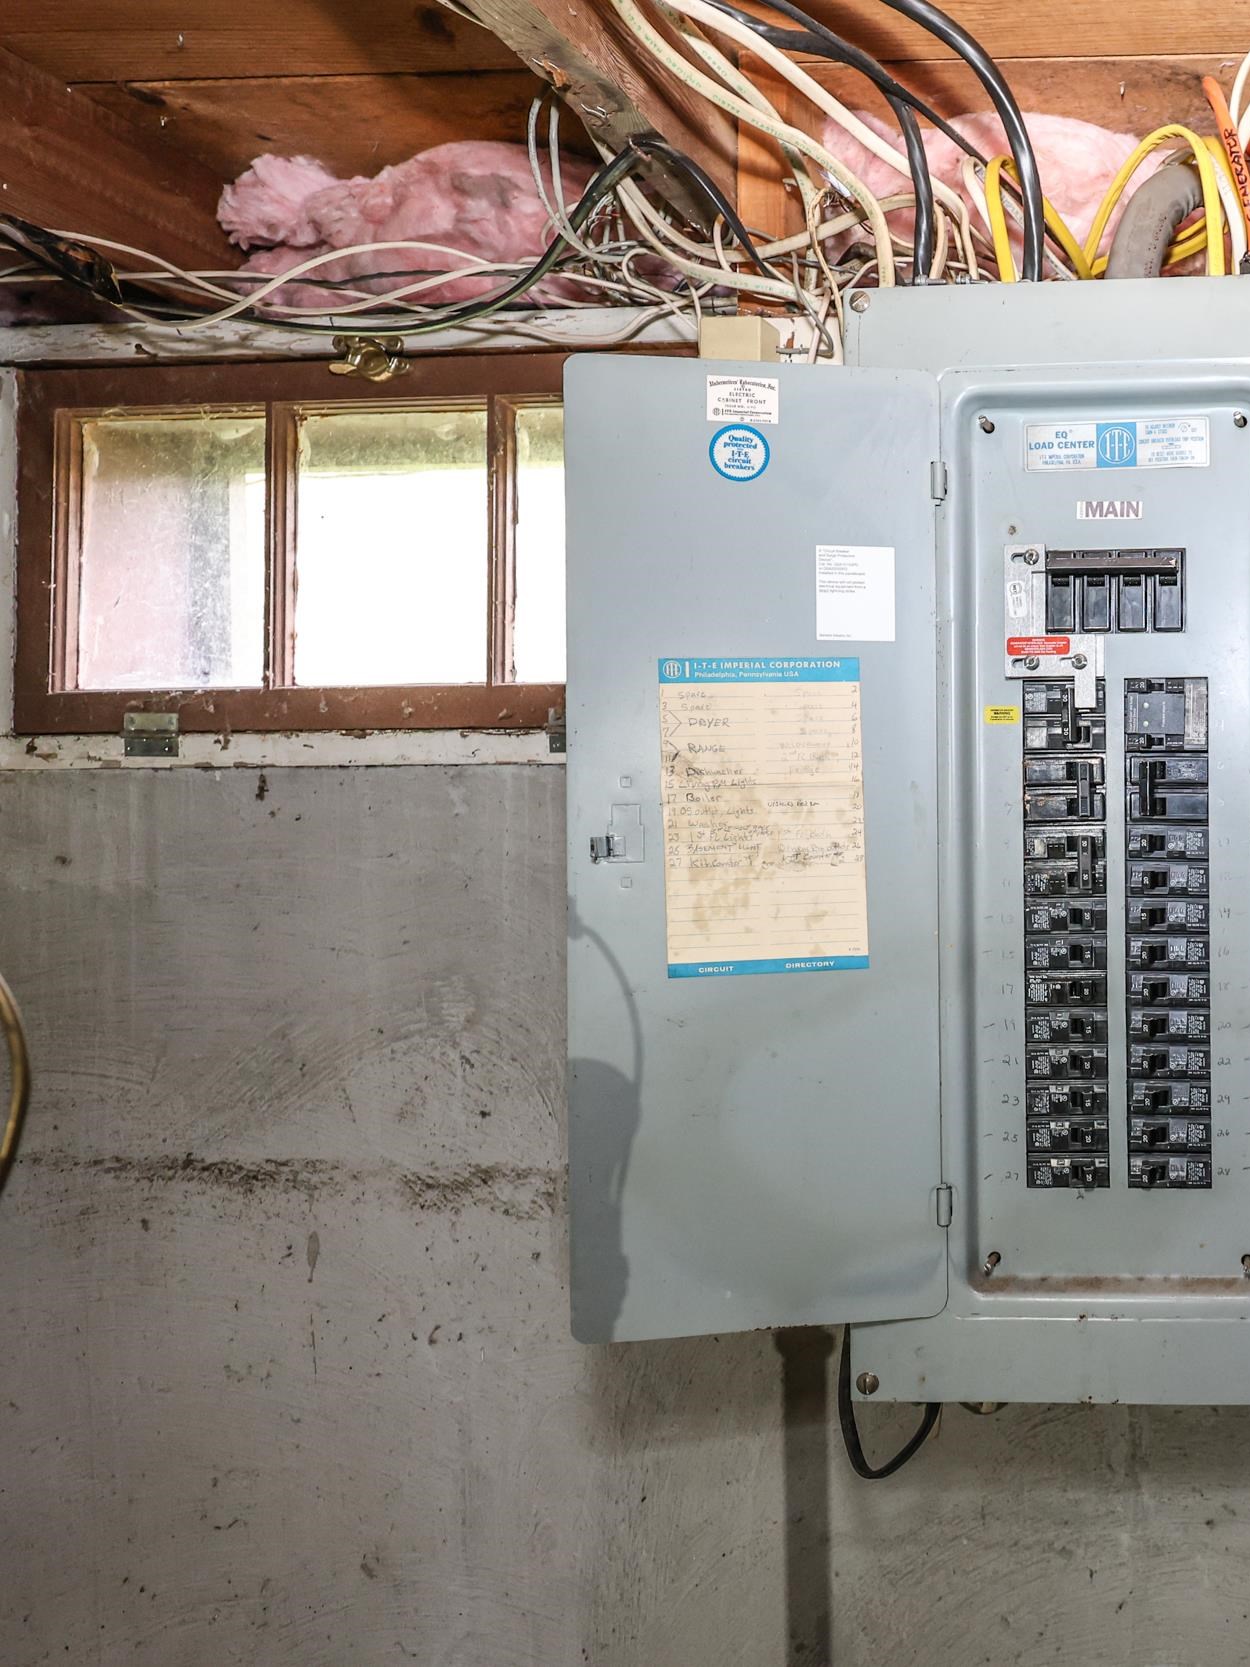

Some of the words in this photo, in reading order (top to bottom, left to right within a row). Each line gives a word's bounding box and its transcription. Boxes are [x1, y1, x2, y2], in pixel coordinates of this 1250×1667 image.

[728, 434, 753, 443] Quality
[1055, 431, 1068, 440] EQ
[723, 441, 757, 449] protected
[1028, 442, 1054, 451] LOAD
[1057, 440, 1095, 449] CENTER
[724, 462, 755, 470] breakers
[1085, 501, 1140, 518] MAIN
[720, 661, 766, 669] IMPERIAL
[769, 660, 841, 669] CORPORATION
[662, 702, 667, 711] 3
[851, 701, 857, 710] 4
[1063, 727, 1069, 736] 30
[687, 742, 726, 753] RANGE
[665, 766, 675, 776] 13
[664, 780, 673, 789] 15
[667, 793, 676, 804] 17
[686, 792, 722, 802] Boiler
[668, 819, 678, 829] 21
[668, 832, 680, 842] 23
[1141, 839, 1147, 847] 20
[668, 845, 680, 855] 25
[669, 858, 682, 868] 27
[1143, 876, 1149, 885] 20
[1084, 911, 1090, 920] 20
[1141, 912, 1147, 921] 15
[1084, 950, 1091, 959] 15
[1141, 951, 1148, 959] 20
[698, 965, 734, 973] CIRCUIT
[785, 960, 835, 969] DIRECTORY
[1143, 988, 1149, 996] 20
[1085, 1025, 1092, 1034] 15
[1143, 1024, 1149, 1032] 20
[1084, 1061, 1091, 1070] 20
[1142, 1061, 1149, 1069] 20
[1085, 1099, 1092, 1107] 15
[1144, 1098, 1150, 1106] 20
[1085, 1135, 1092, 1143] 20
[1142, 1134, 1149, 1143] 20
[1086, 1172, 1093, 1182] 20
[1142, 1174, 1149, 1183] 20
